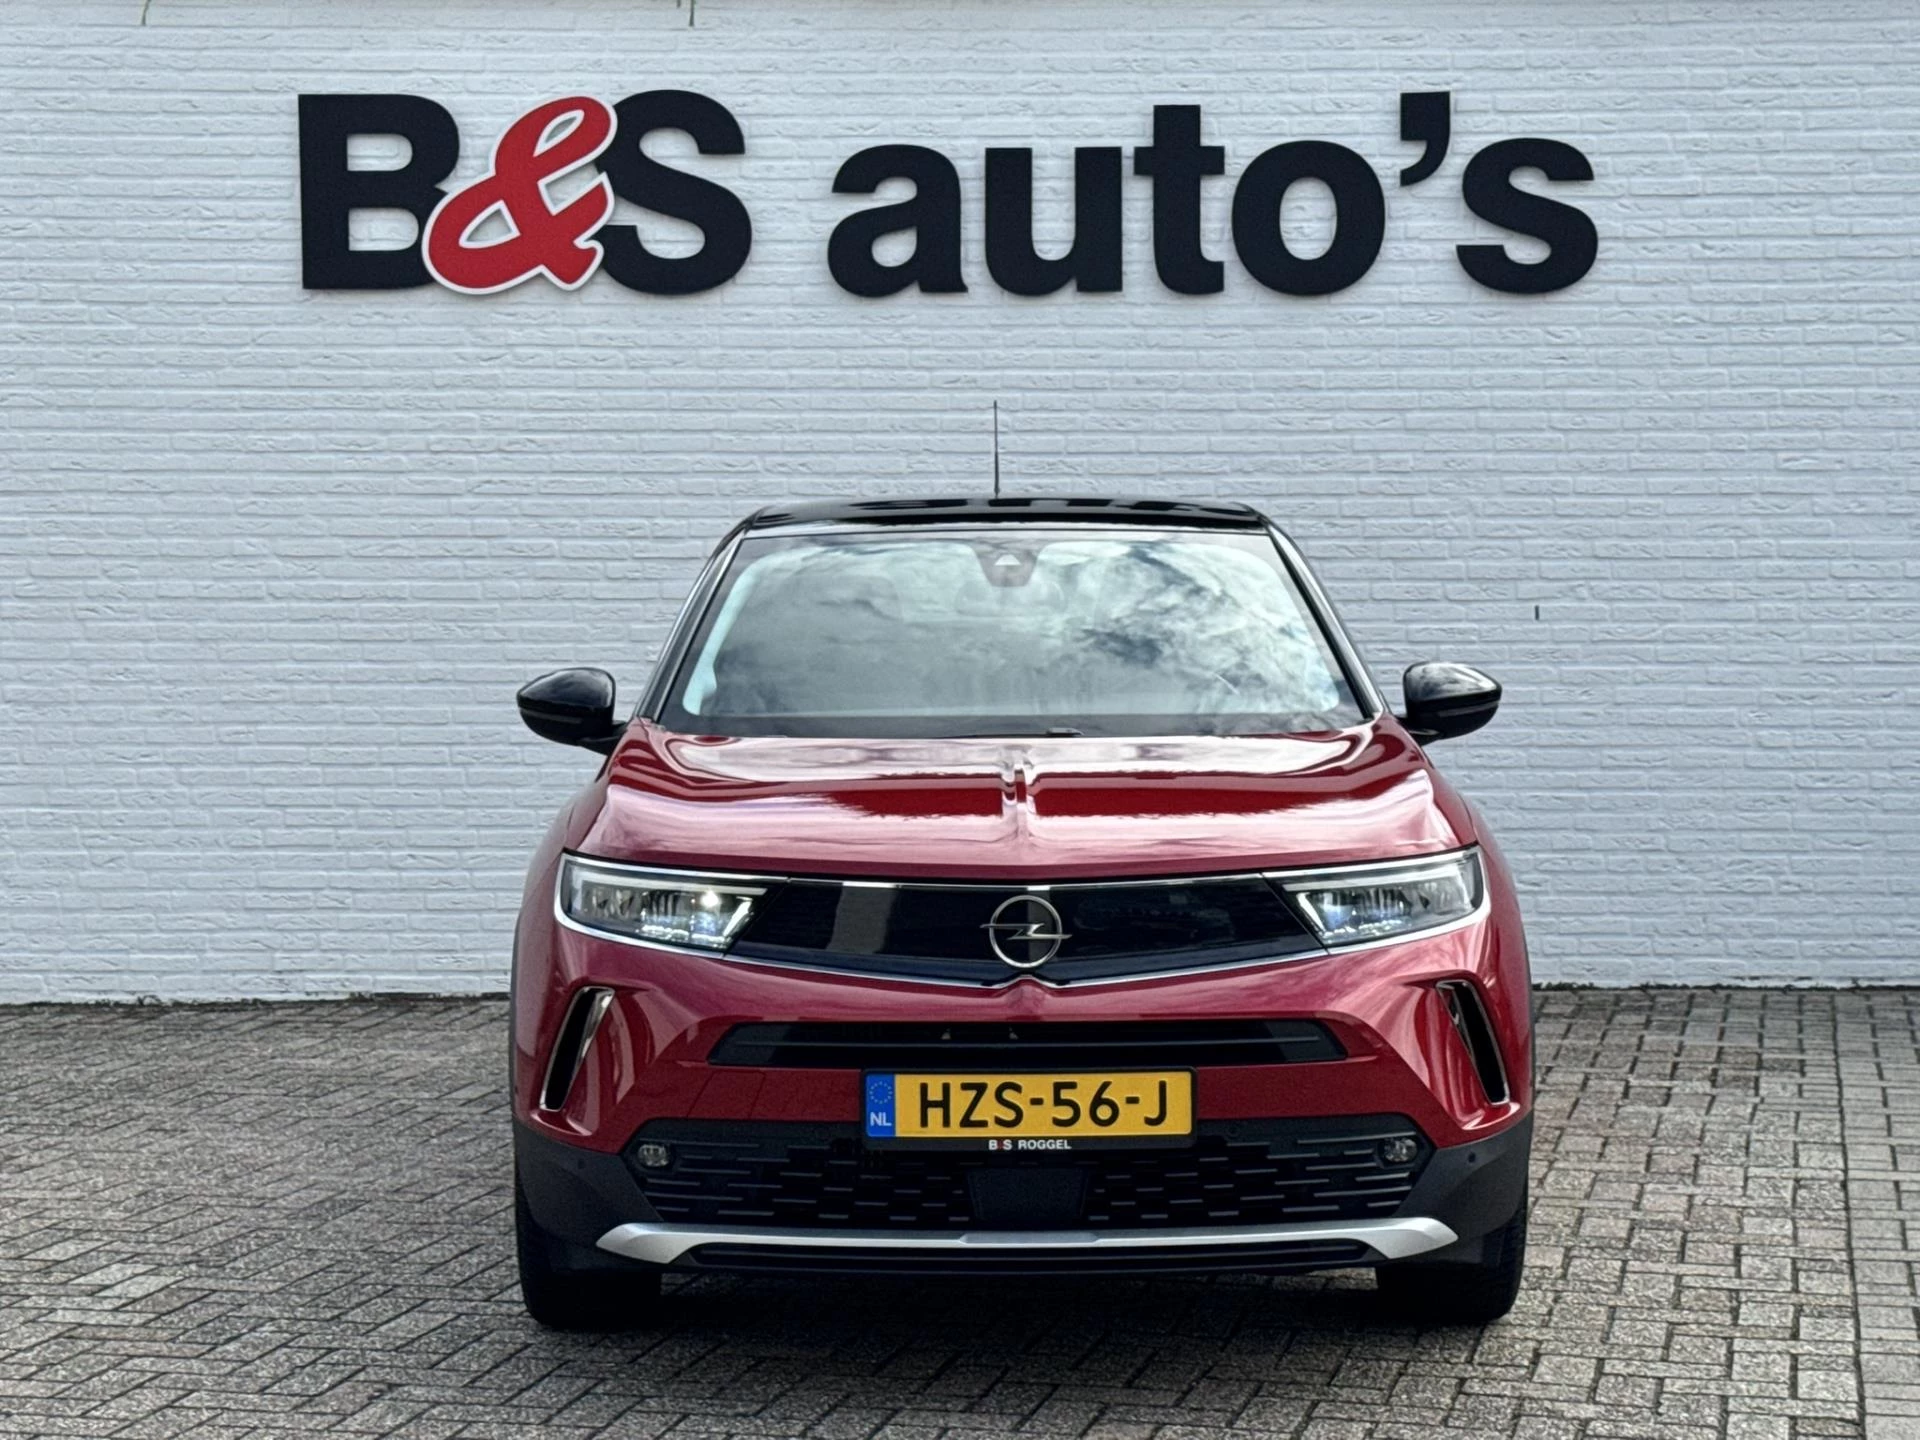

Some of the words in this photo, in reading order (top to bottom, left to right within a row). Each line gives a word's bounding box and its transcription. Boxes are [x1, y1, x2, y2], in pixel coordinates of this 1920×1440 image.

[299, 90, 752, 295] B&S
[828, 91, 1599, 296] auto's
[870, 1112, 892, 1127] NL
[919, 1080, 1168, 1128] HZS-56-J
[1018, 1139, 1072, 1150] ROGGEL
